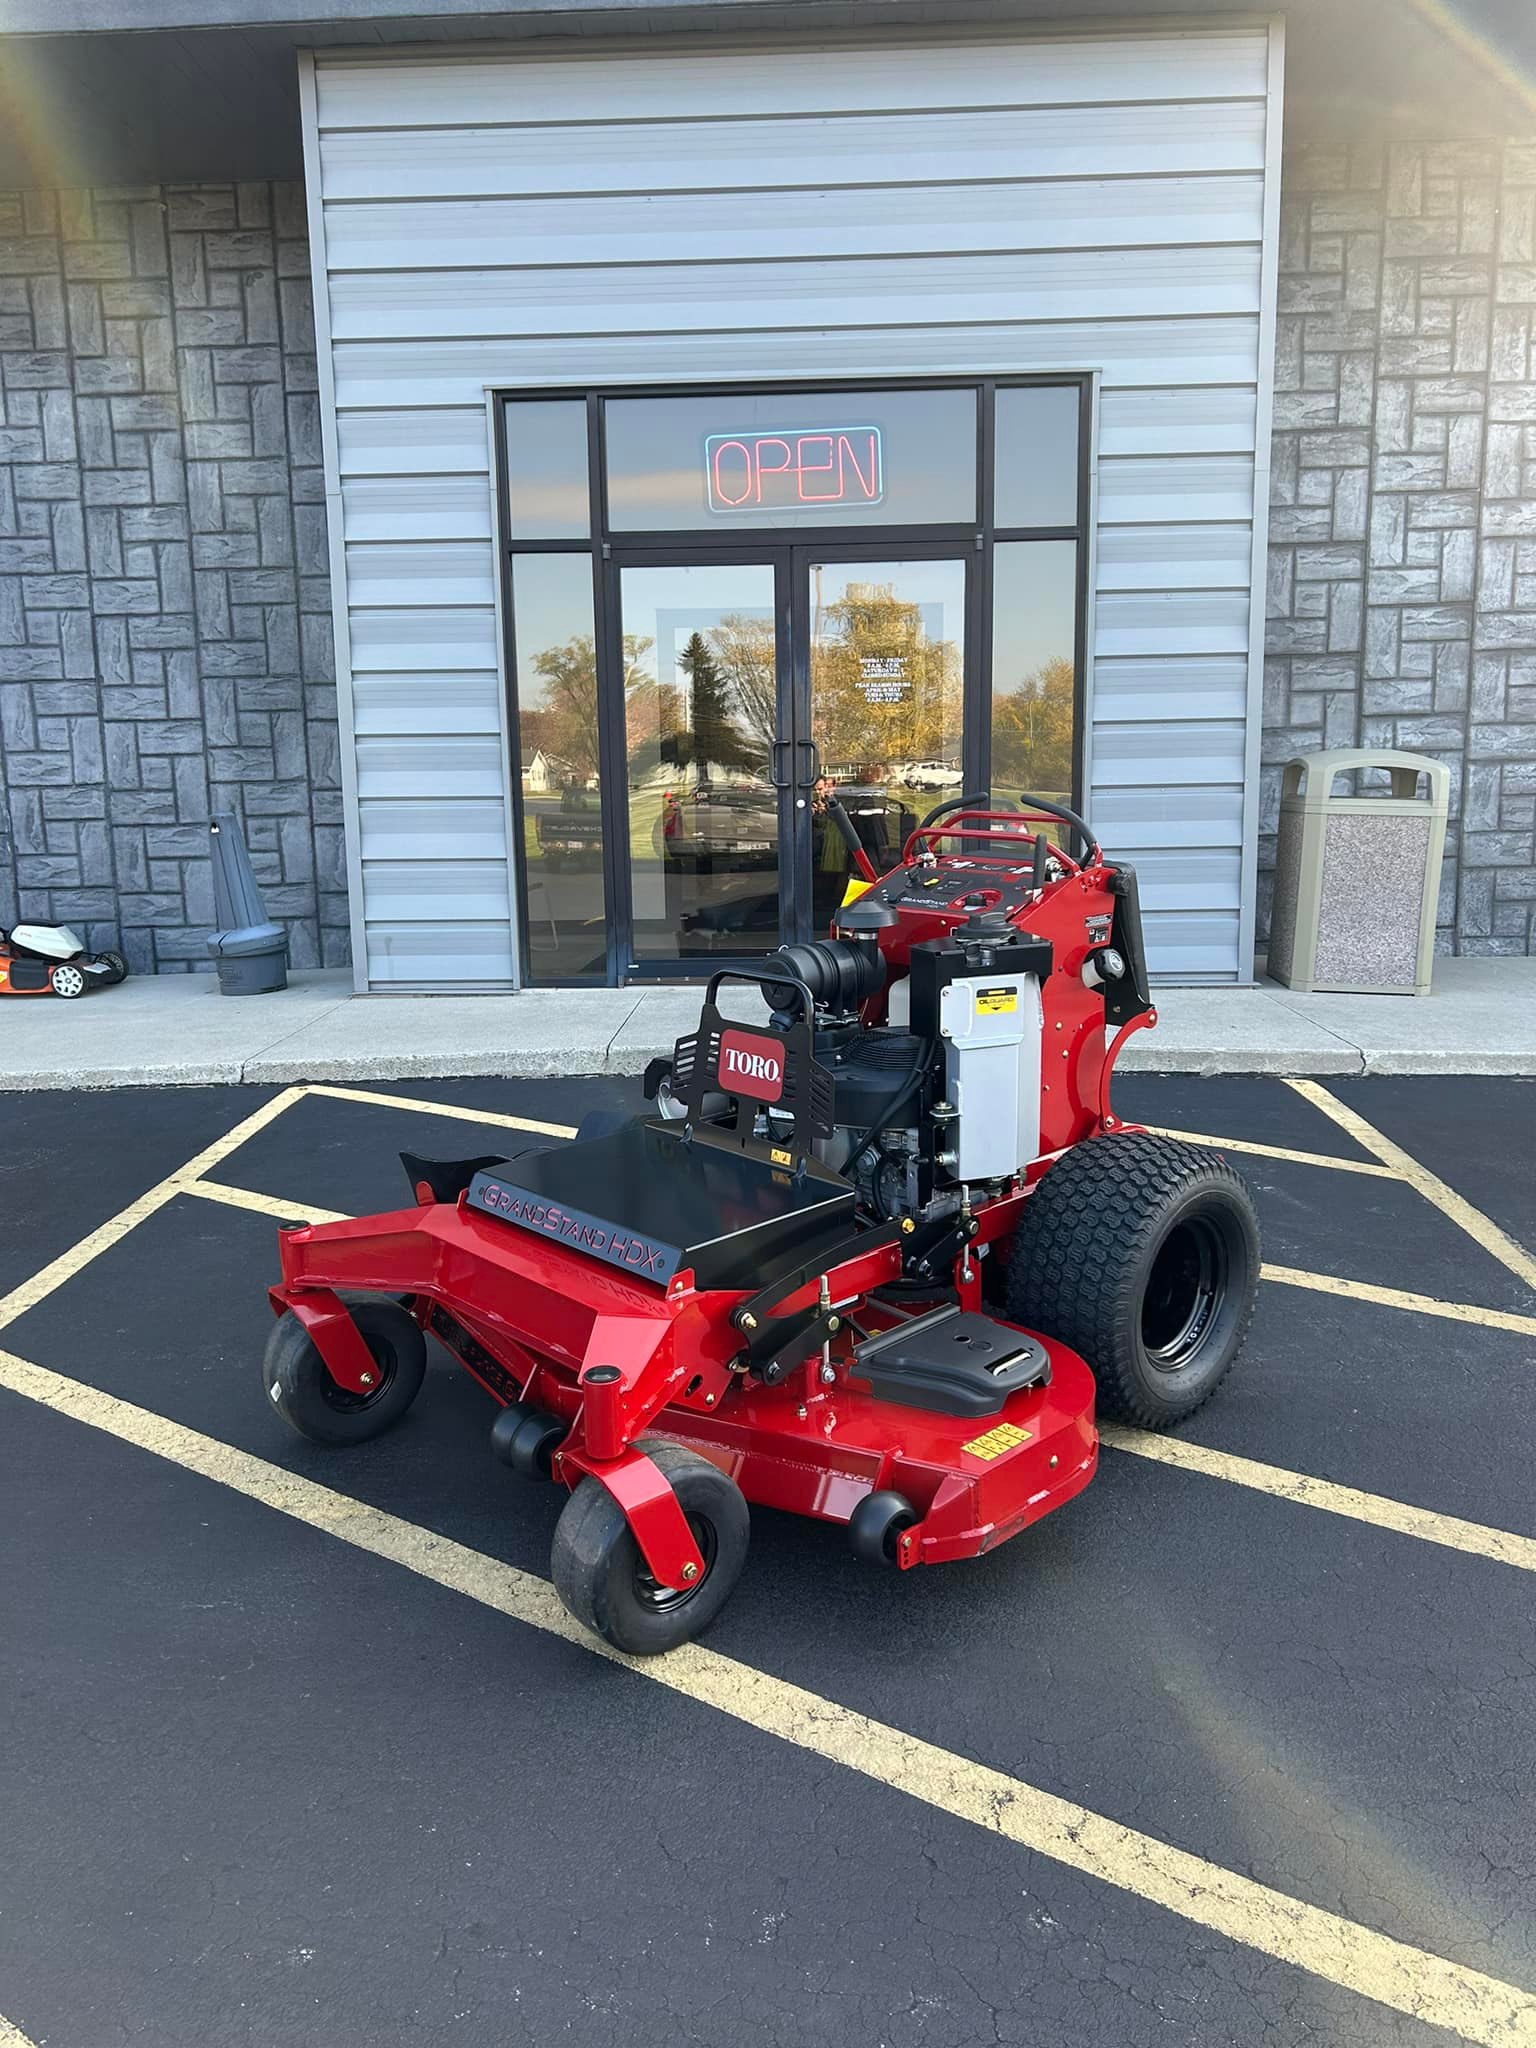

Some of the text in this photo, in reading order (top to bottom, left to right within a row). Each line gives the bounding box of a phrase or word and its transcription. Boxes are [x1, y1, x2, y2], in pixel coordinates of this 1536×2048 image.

[714, 434, 875, 505] OPEN
[725, 1048, 780, 1081] TORO
[607, 1233, 662, 1273] HDX
